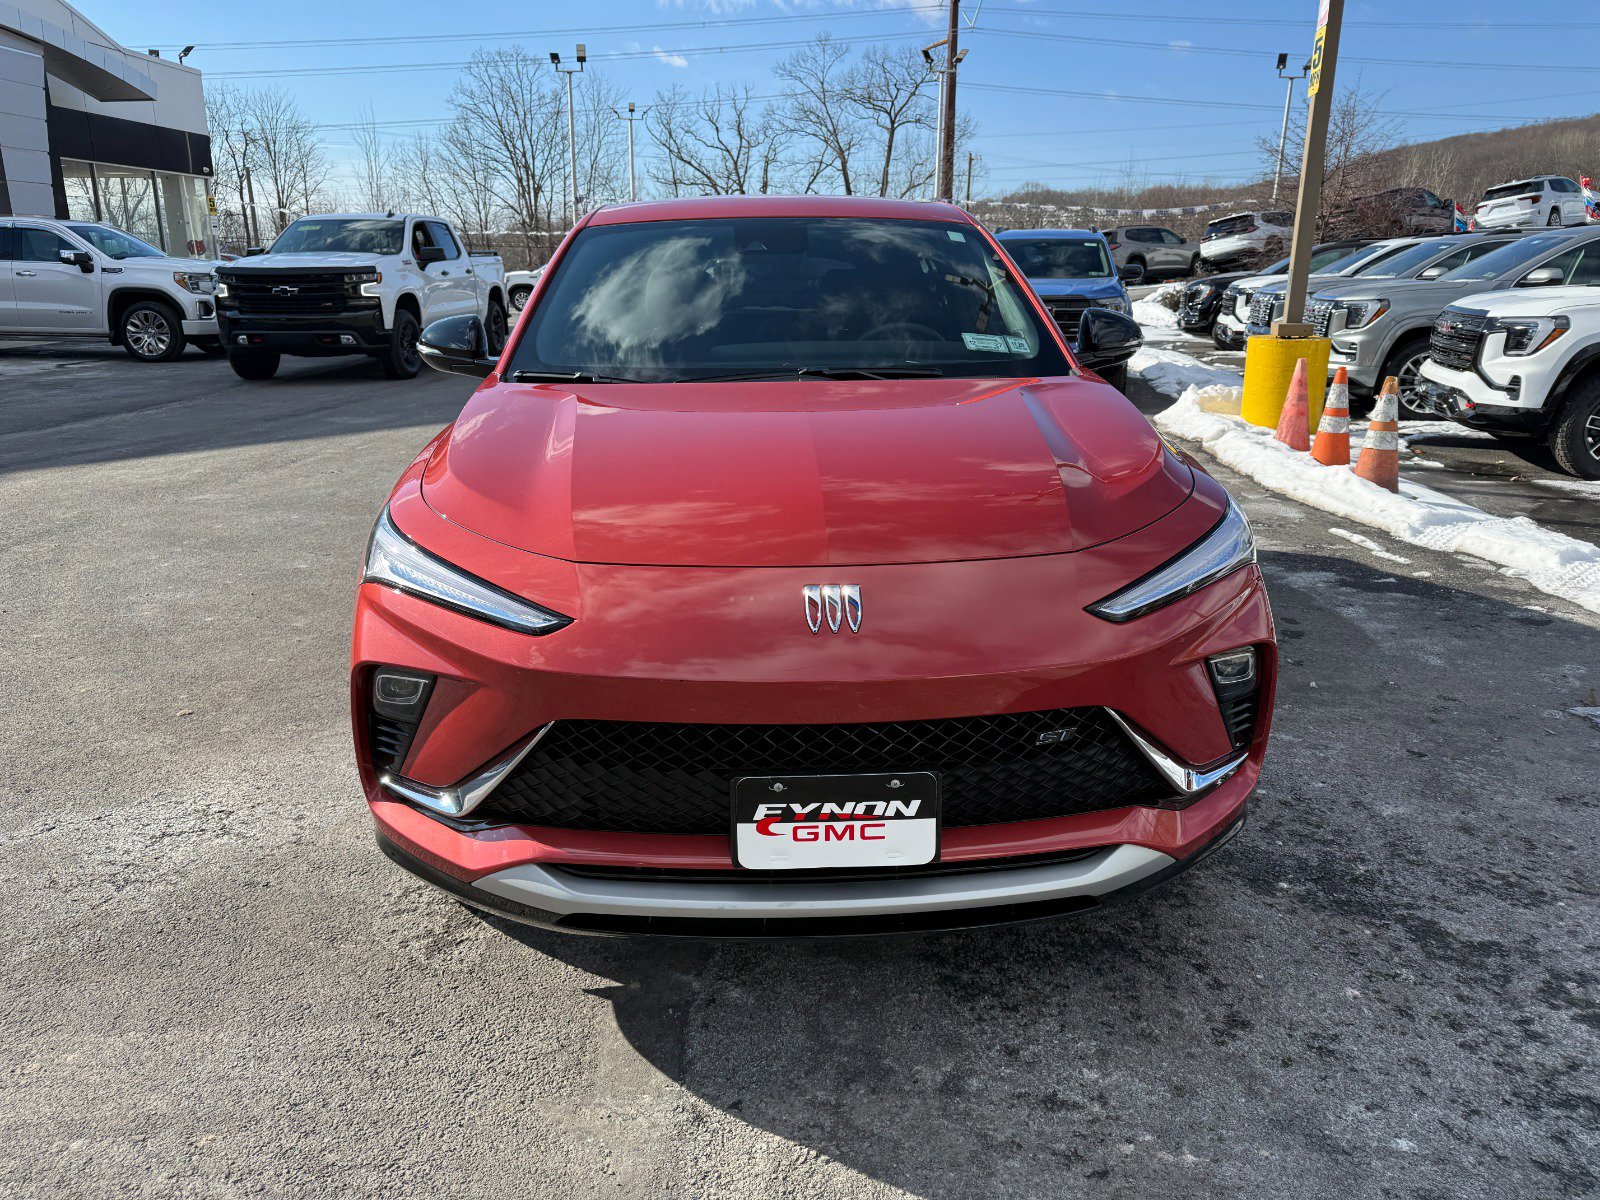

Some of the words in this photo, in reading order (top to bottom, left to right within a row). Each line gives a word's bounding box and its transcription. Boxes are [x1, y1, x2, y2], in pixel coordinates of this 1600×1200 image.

[1313, 36, 1323, 70] 5
[209, 197, 215, 208] 5
[1036, 726, 1078, 746] ST
[752, 799, 922, 822] EYNON
[792, 822, 886, 843] GMC
